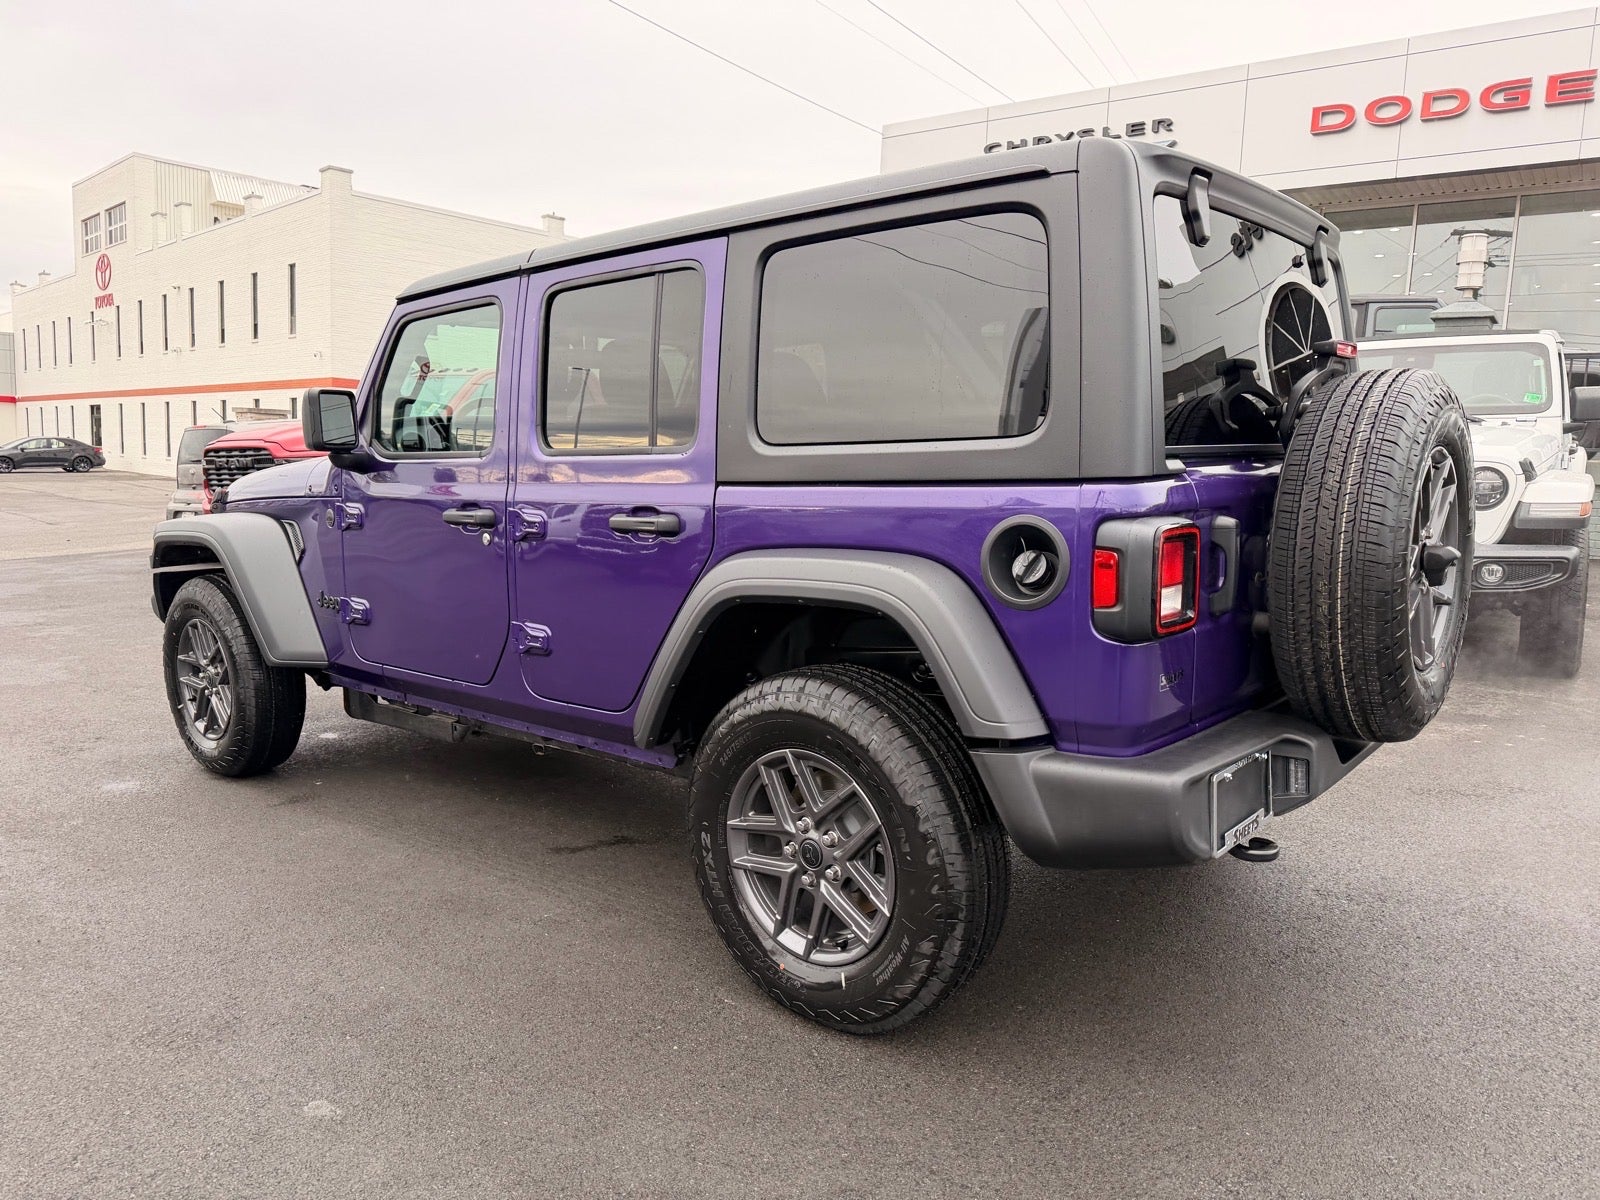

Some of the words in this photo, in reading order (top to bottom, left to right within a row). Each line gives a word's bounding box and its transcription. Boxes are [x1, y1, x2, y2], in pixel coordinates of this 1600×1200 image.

[1310, 68, 1598, 135] DODGE
[95, 293, 114, 310] TOYOTA
[215, 458, 253, 469] RAM
[317, 590, 340, 614] Jeep
[1233, 815, 1260, 844] SHEETS
[874, 934, 912, 986] All-Weather
